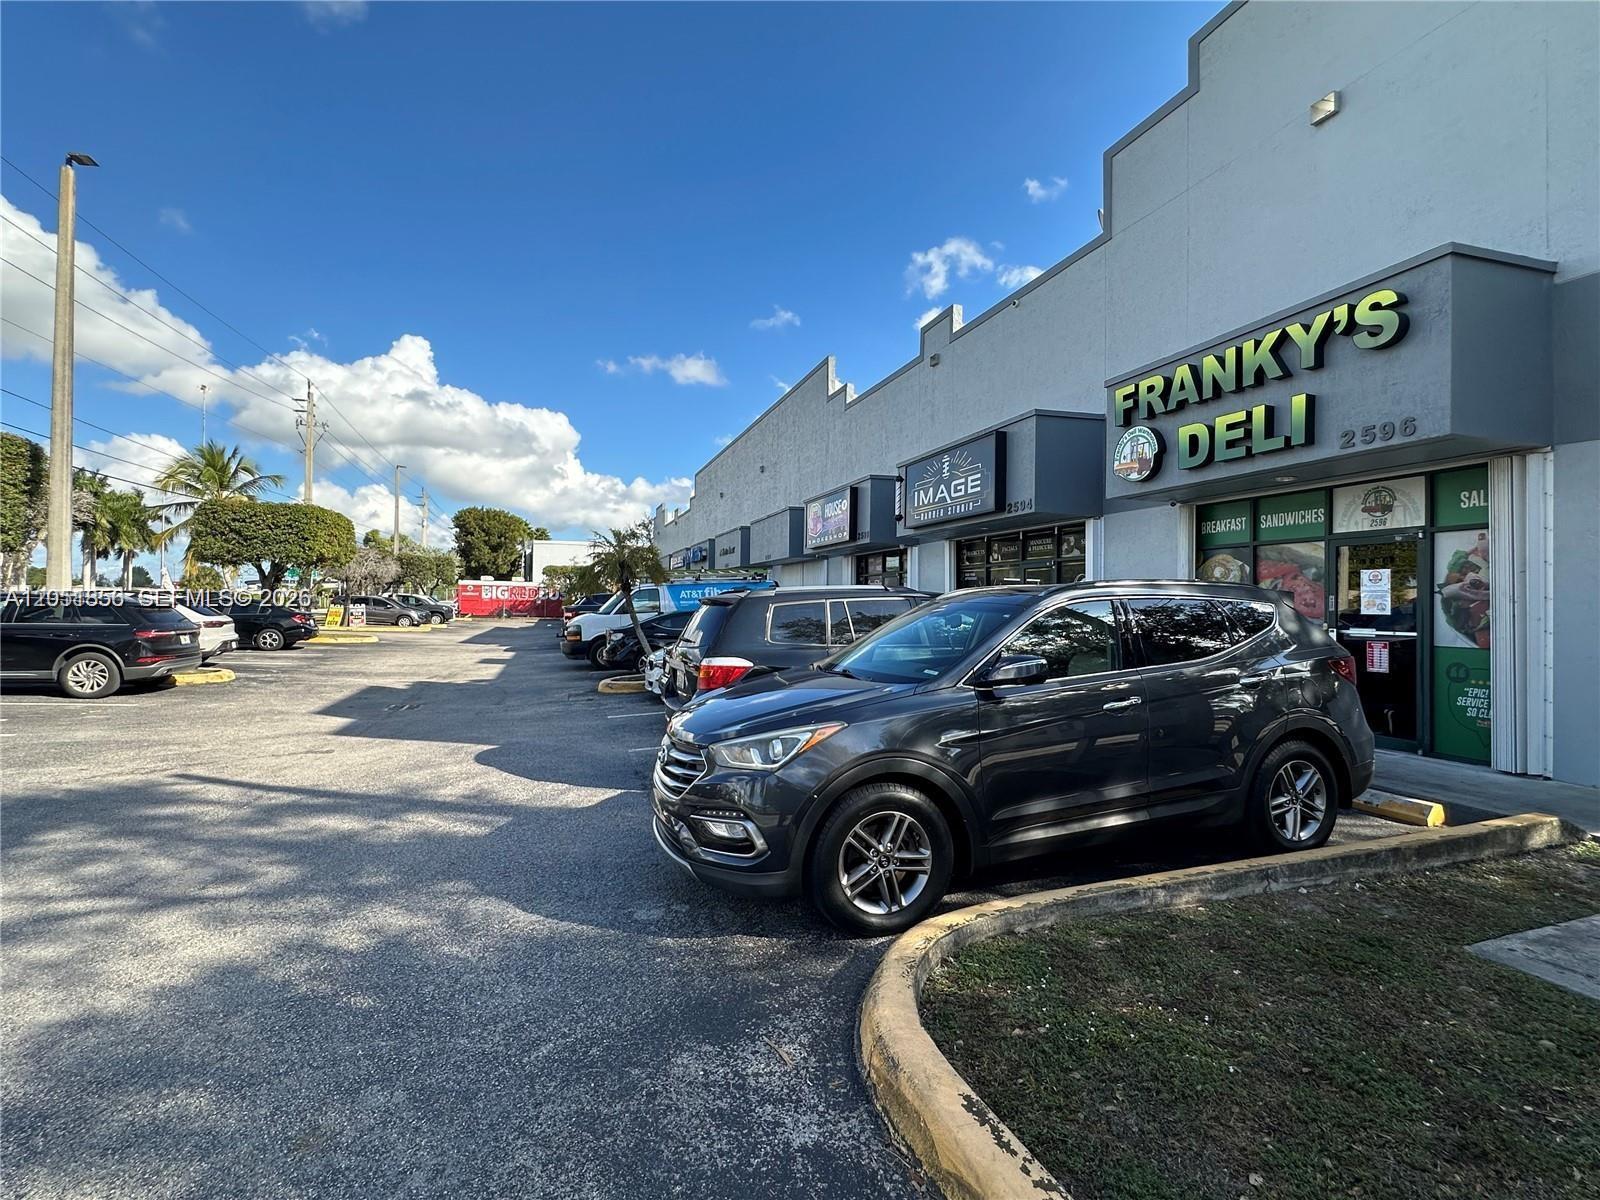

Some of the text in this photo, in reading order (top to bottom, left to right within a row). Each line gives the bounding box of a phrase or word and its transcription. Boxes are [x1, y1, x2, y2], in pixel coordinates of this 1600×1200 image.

[1114, 288, 1411, 427] FRANKY'S
[1178, 392, 1316, 470] DELI
[1340, 416, 1416, 449] 2596
[914, 473, 981, 507] IMAGE
[824, 499, 842, 518] HOUSE
[920, 502, 973, 520] BARBER STUDIO
[1007, 498, 1033, 514] 2594
[1201, 517, 1247, 534] BREAKFAST
[1260, 508, 1325, 529] SANDWICHES
[680, 590, 702, 599] AT&T
[1456, 697, 1489, 708] SERVICE
[1466, 707, 1478, 717] SO
